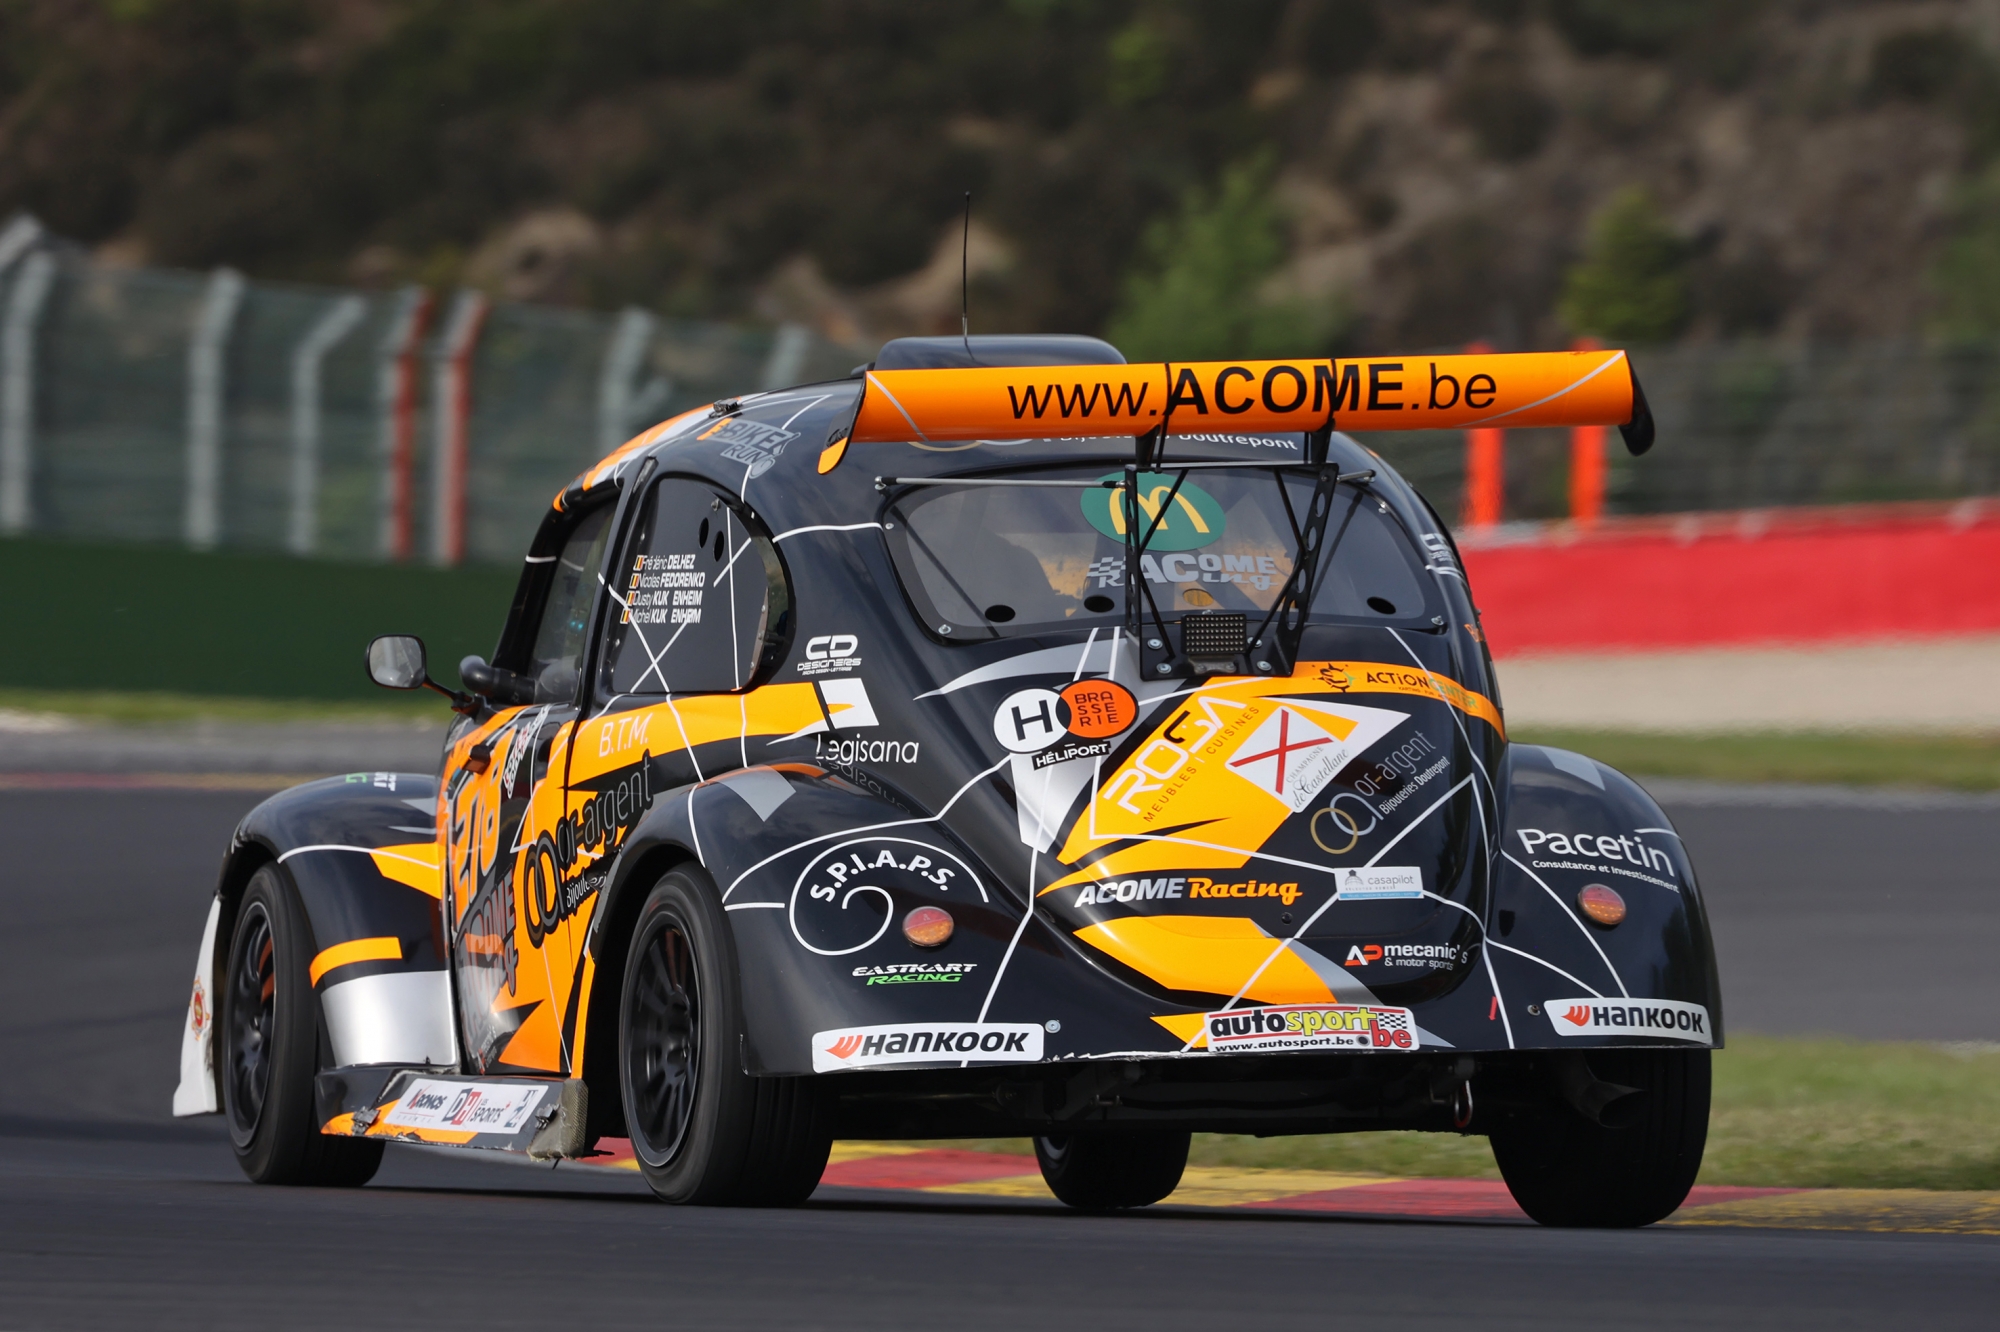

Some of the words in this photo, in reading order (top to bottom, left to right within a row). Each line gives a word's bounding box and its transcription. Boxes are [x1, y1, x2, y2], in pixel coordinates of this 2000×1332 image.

[1007, 362, 1497, 419] www.ACOME.be
[724, 444, 769, 463] RUN
[667, 554, 696, 570] DELHEZ
[639, 573, 660, 588] Nicolas
[660, 572, 705, 588] FEDORENKO
[633, 590, 653, 609] Dusty
[806, 634, 858, 660] CD
[797, 657, 862, 672] DESIGNERS
[1011, 699, 1054, 741] H
[599, 712, 653, 758] B.T.M.
[816, 733, 919, 766] Legisana
[1036, 743, 1108, 767] HÉLIPORT
[1354, 730, 1436, 797] or-argent
[1143, 766, 1198, 823] MEUBLES
[1205, 706, 1259, 755] CUISINES
[1286, 745, 1324, 784] CHAMPAGNE
[1300, 748, 1350, 798] Castellane
[1379, 782, 1418, 815] Bijouteries
[1414, 755, 1451, 786] Doutrepont
[1517, 828, 1675, 877] Pacetin
[1532, 860, 1596, 872] Consultance
[1599, 864, 1610, 873] et
[810, 850, 955, 902] S.P.I.A.P.S.
[1367, 874, 1414, 889] casapilot
[1074, 877, 1185, 908] ACOME
[1187, 877, 1303, 906] Racing
[852, 964, 977, 977] EASTKART
[1384, 957, 1393, 967] &
[1396, 959, 1427, 967] motor
[1429, 960, 1454, 971] sports
[866, 973, 963, 985] RACING
[1210, 1007, 1377, 1038] autosport
[1370, 1020, 1413, 1048] be
[1215, 1034, 1354, 1051] www.autosport.be
